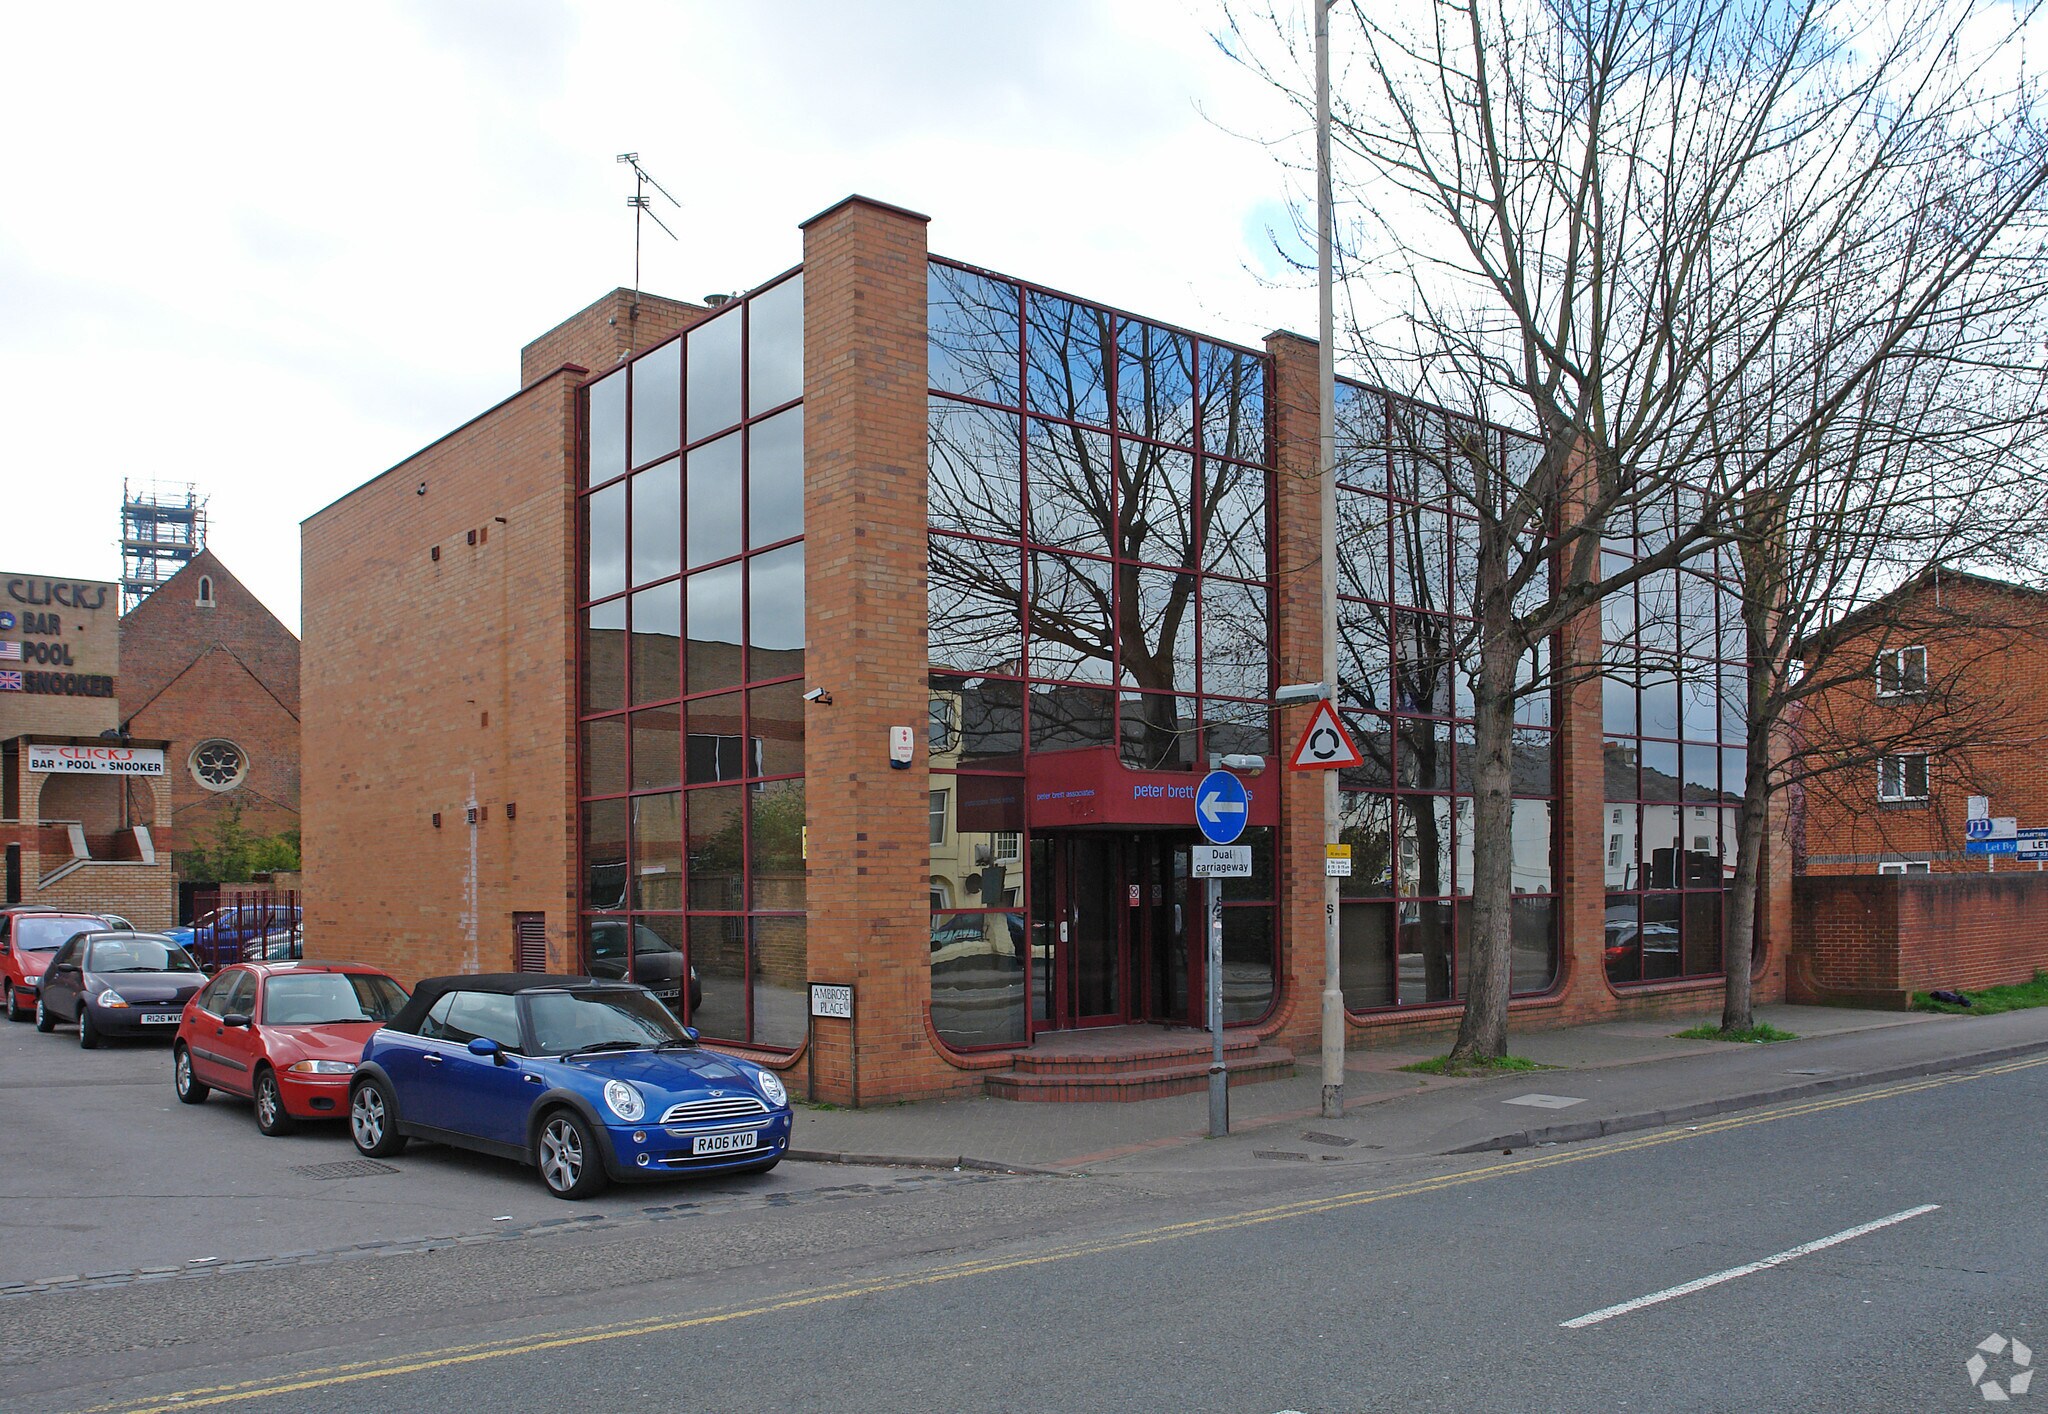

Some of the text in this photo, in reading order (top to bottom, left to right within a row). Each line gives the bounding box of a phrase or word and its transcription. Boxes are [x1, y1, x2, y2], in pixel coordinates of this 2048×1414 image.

[7, 578, 108, 609] CLICKS
[23, 611, 61, 635] BAR
[23, 640, 74, 666] POOL
[24, 670, 114, 697] SNOOKER
[59, 747, 135, 760] CLICKS
[31, 759, 161, 772] BAR POOL SNOOKER
[1133, 784, 1195, 800] peter brett
[1985, 842, 2015, 852] Let By
[1212, 849, 1233, 859] Dual
[1195, 862, 1249, 873] carriageway
[1326, 904, 1334, 914] S
[814, 988, 849, 1001] AMBROSE
[820, 1001, 844, 1014] PLACE
[698, 1133, 753, 1151] RA06 KVD
